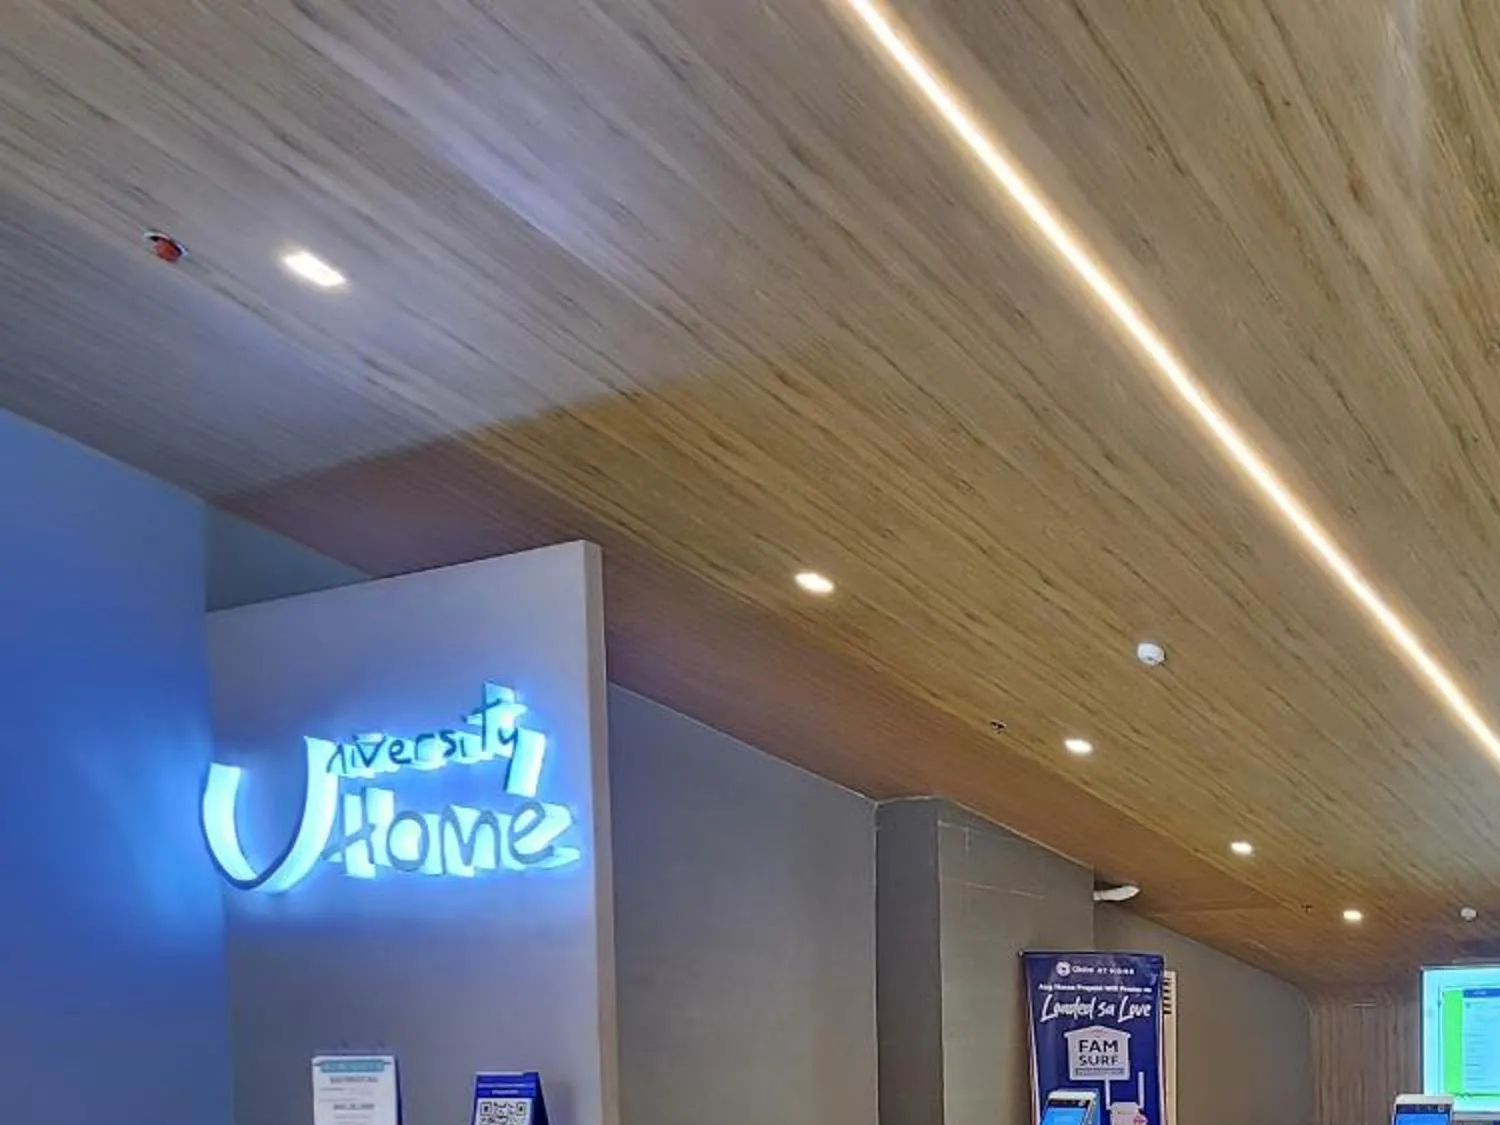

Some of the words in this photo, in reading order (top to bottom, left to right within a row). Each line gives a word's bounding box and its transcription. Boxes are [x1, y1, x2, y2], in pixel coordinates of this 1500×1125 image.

[322, 786, 582, 879] Home
[1117, 995, 1151, 1022] Love
[1078, 1039, 1119, 1053] FAM
[1078, 1055, 1119, 1067] SURF
